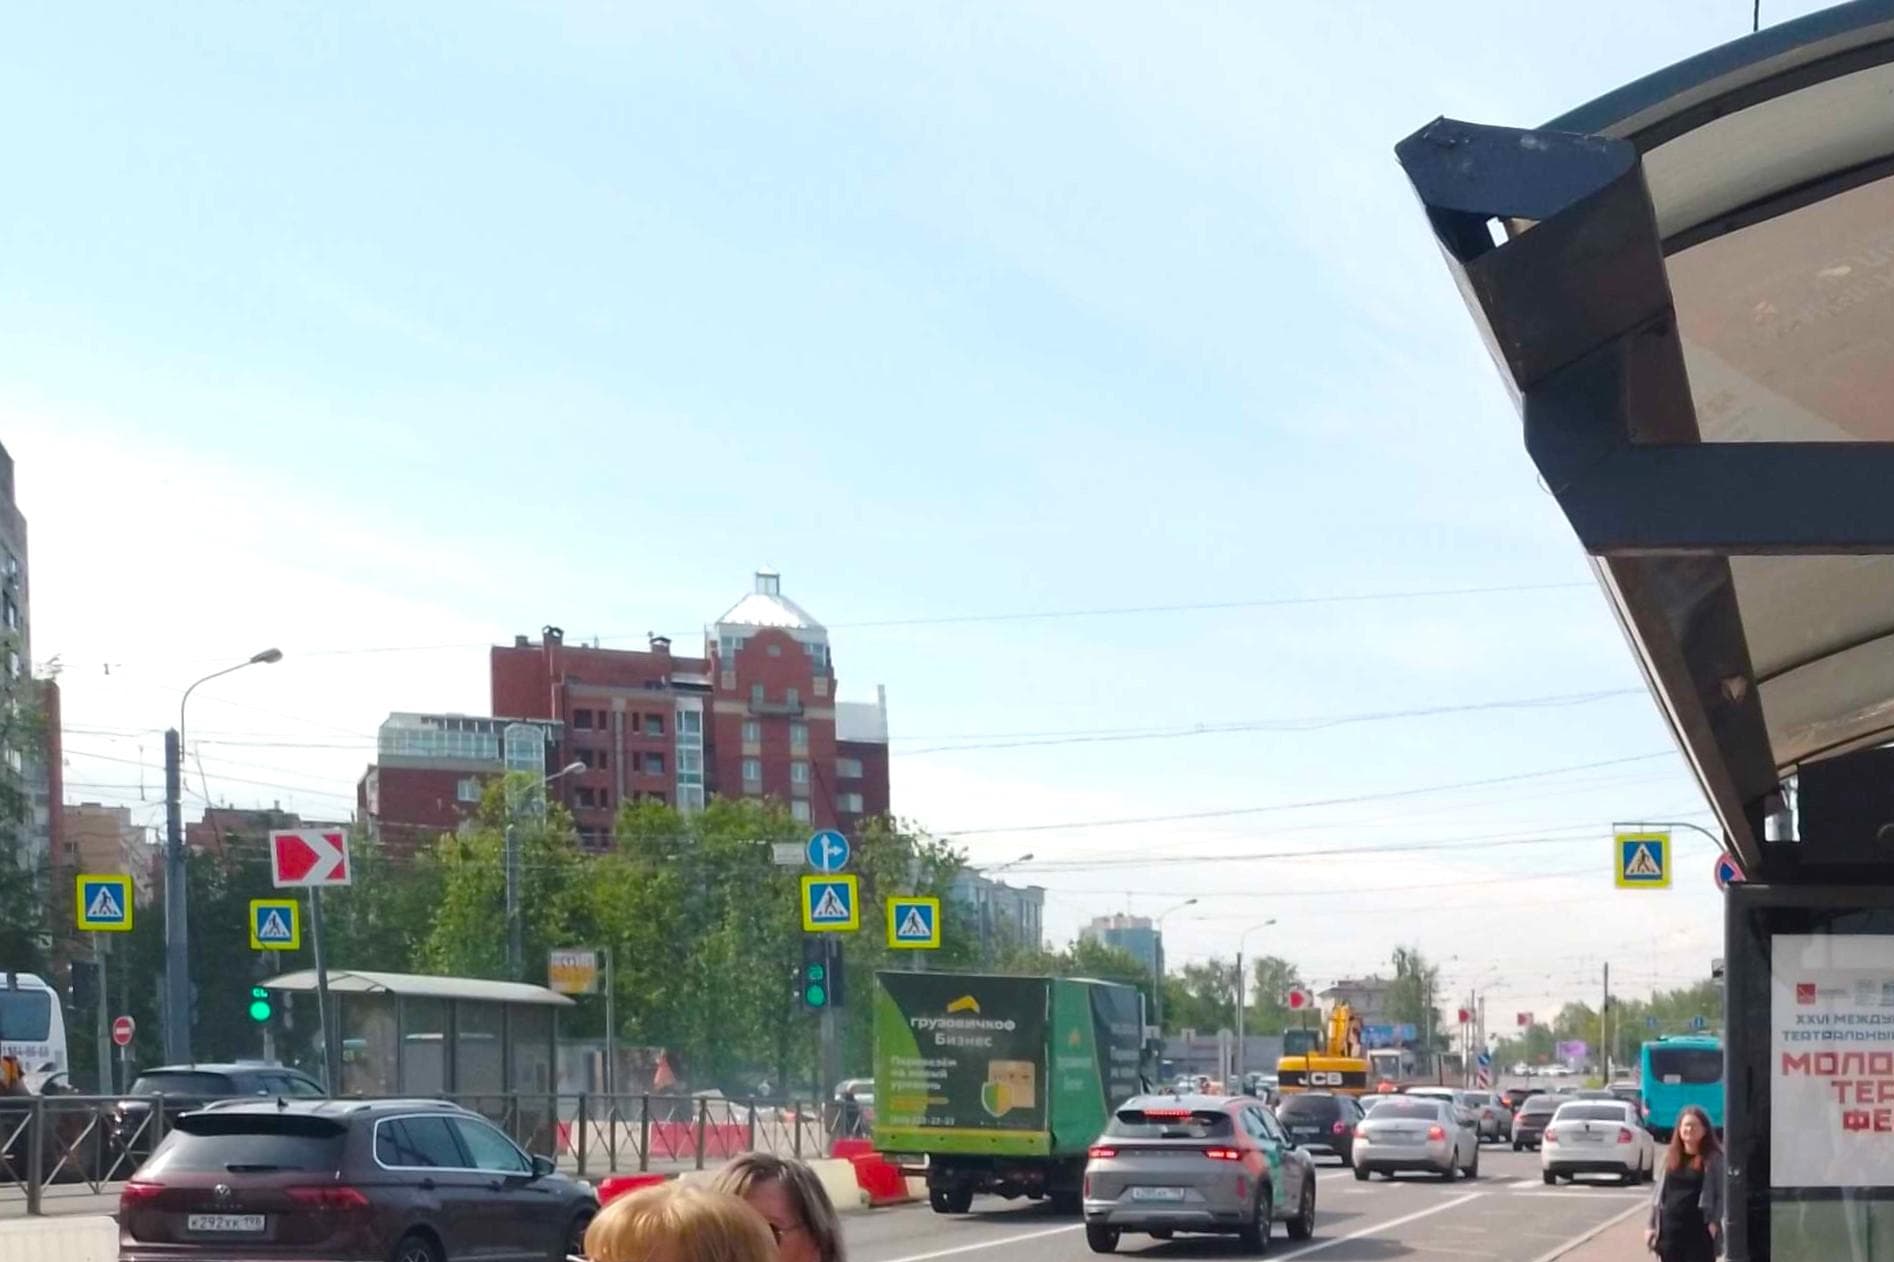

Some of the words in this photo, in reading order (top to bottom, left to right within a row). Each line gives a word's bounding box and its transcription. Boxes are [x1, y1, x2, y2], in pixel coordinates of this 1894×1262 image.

[911, 1017, 1016, 1031] грузовичкоф
[935, 1033, 992, 1047] Бизнес
[1298, 1072, 1343, 1086] JCB
